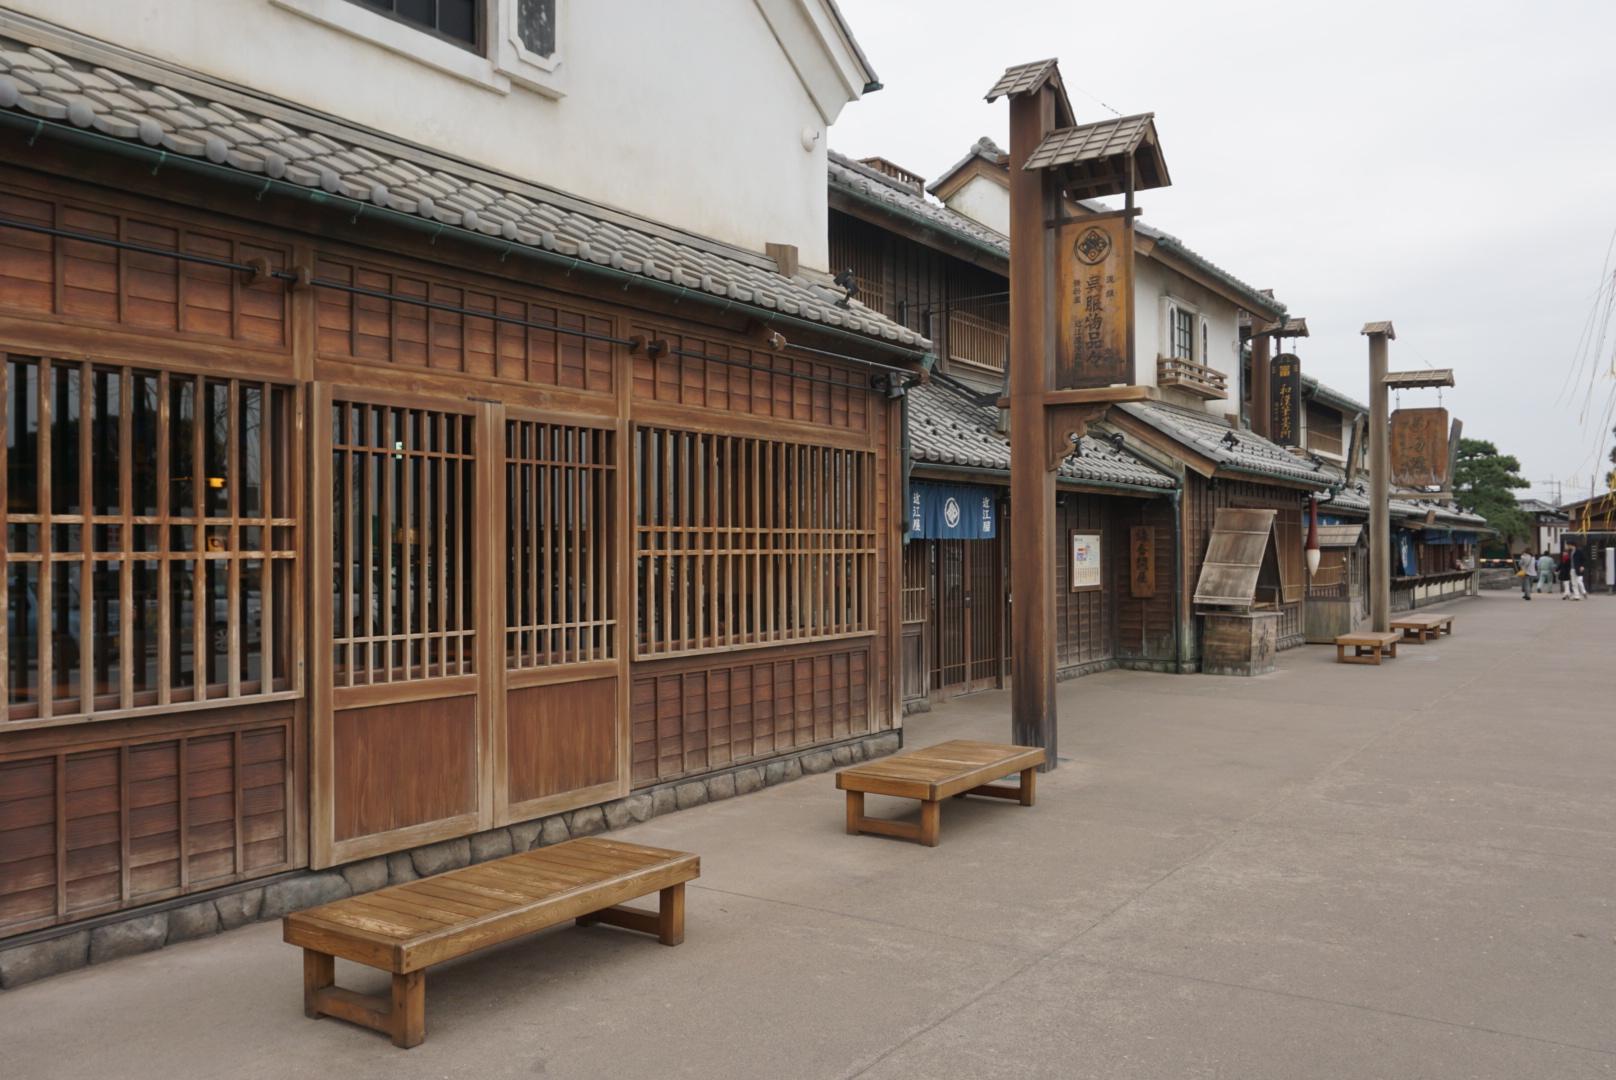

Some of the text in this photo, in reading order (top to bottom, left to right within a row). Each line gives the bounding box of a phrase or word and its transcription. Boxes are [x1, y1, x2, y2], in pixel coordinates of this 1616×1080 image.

[912, 492, 921, 532] 近江屋
[982, 496, 991, 532] 近江屋
